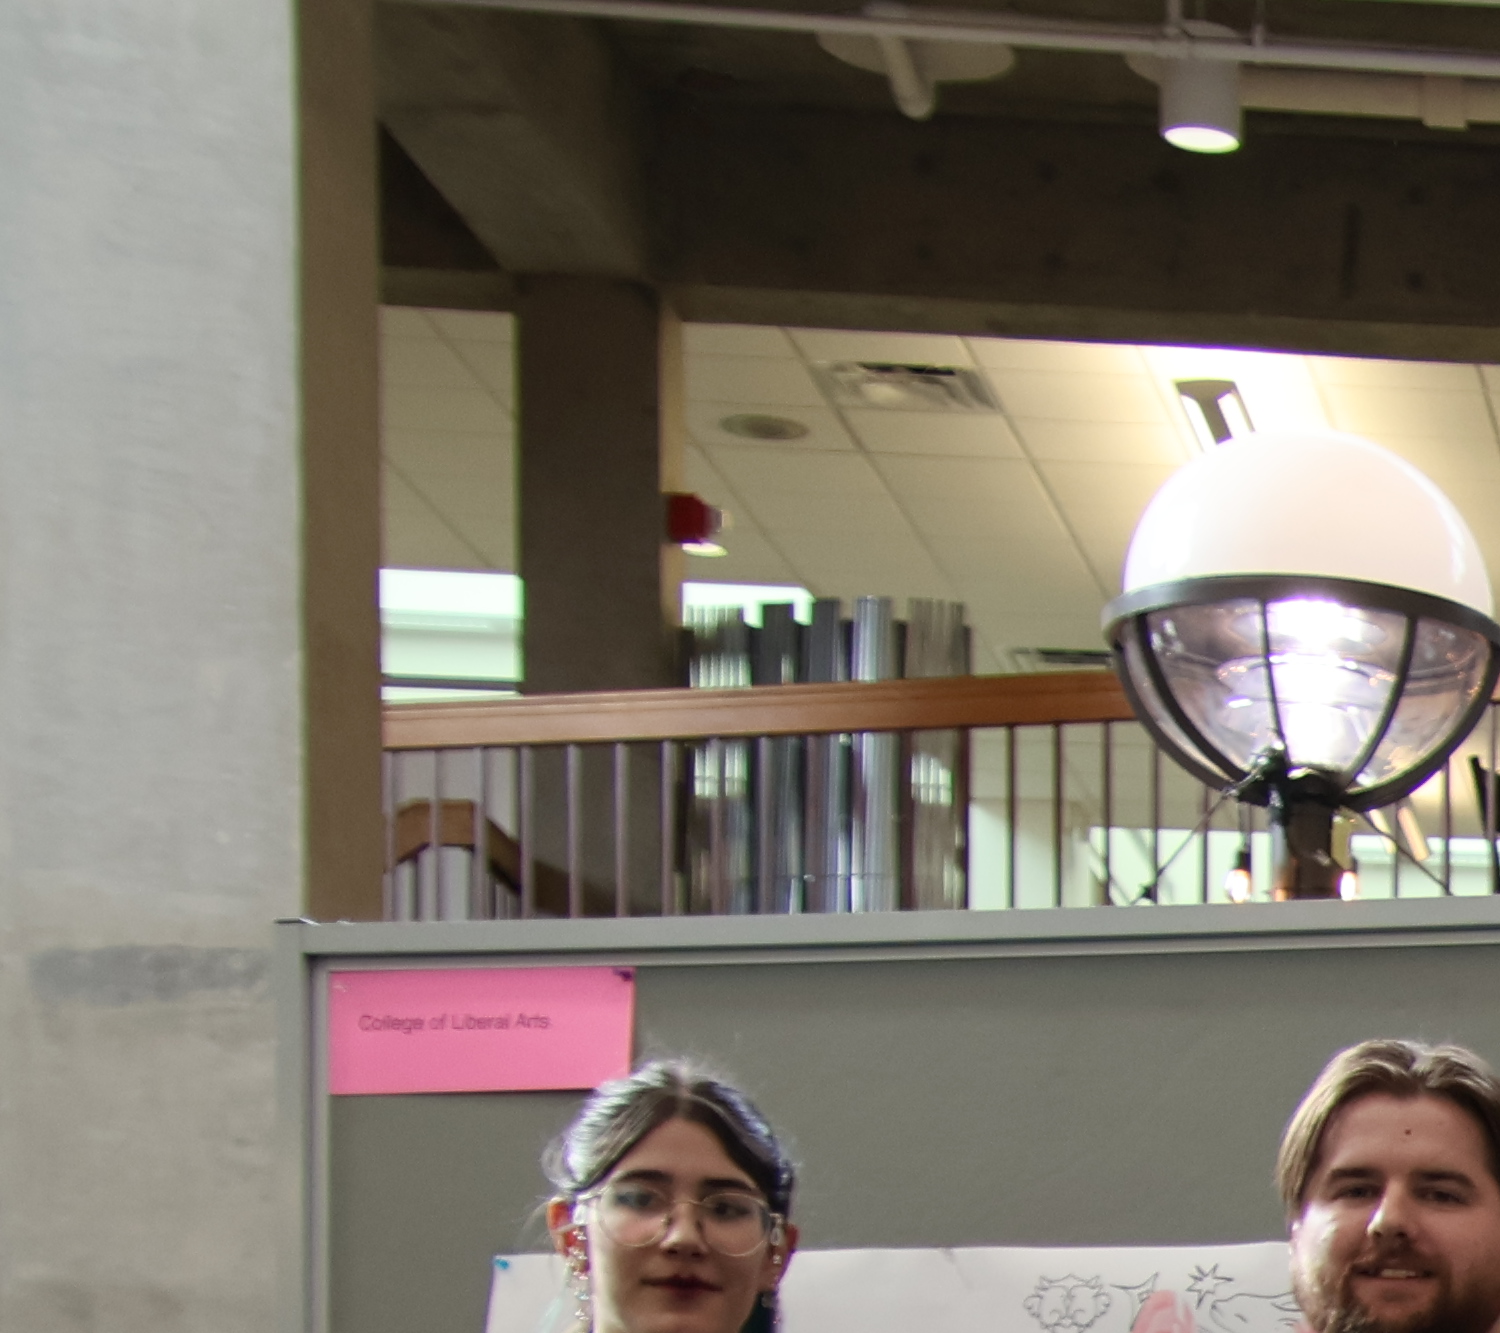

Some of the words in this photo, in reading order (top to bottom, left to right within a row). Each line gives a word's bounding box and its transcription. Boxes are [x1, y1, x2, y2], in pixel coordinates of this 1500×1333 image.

[359, 1015, 424, 1033] College
[429, 1014, 446, 1030] of
[452, 1015, 508, 1030] Liberal
[516, 1014, 549, 1029] Arts
